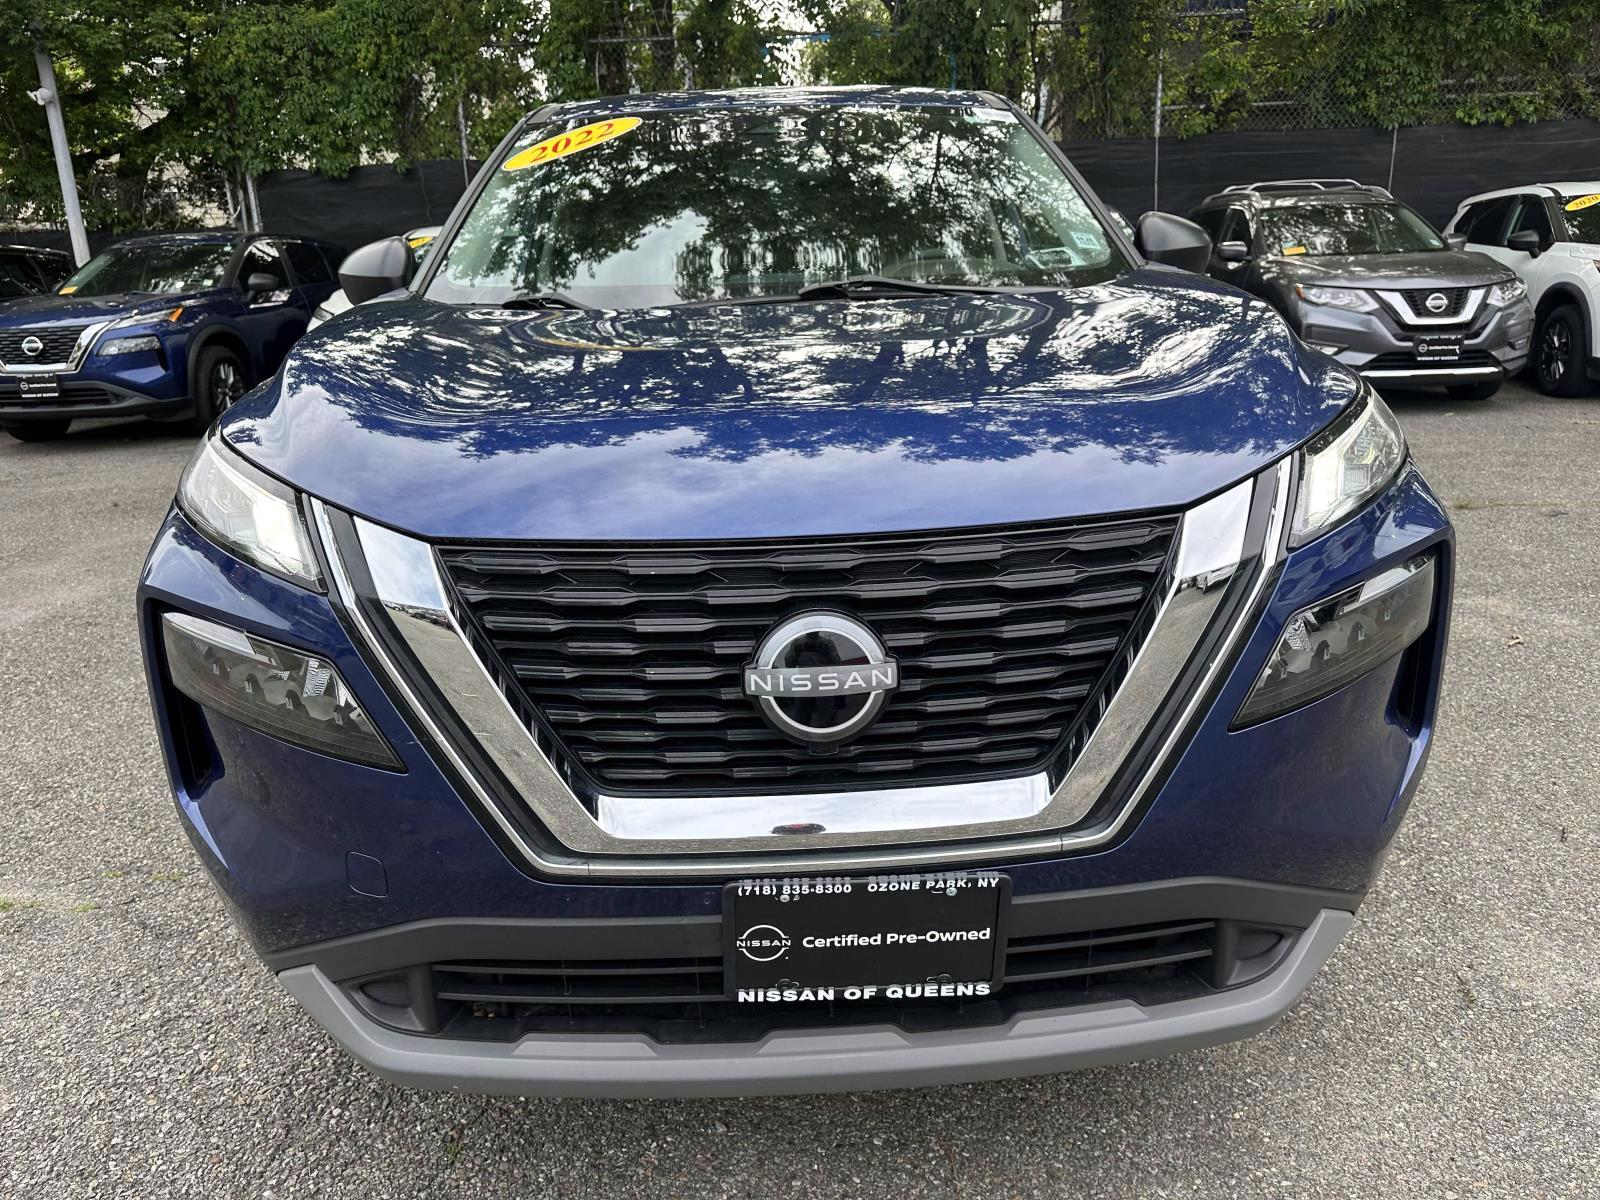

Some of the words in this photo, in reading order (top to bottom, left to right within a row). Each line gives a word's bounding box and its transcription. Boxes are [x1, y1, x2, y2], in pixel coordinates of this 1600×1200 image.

[529, 123, 614, 164] 2022
[750, 667, 893, 692] NISSAN
[738, 885, 777, 896] (718)
[782, 884, 852, 895] 835-8300
[867, 881, 920, 892] OZONE
[926, 879, 972, 890] PARK,
[977, 877, 1000, 888] NY
[736, 939, 791, 947] NISSAN
[802, 933, 882, 948] Certified
[886, 927, 990, 945] Pre-Owned
[738, 988, 834, 1003] NISSAN
[844, 987, 877, 1001] OF
[885, 984, 990, 1000] QUEENS
